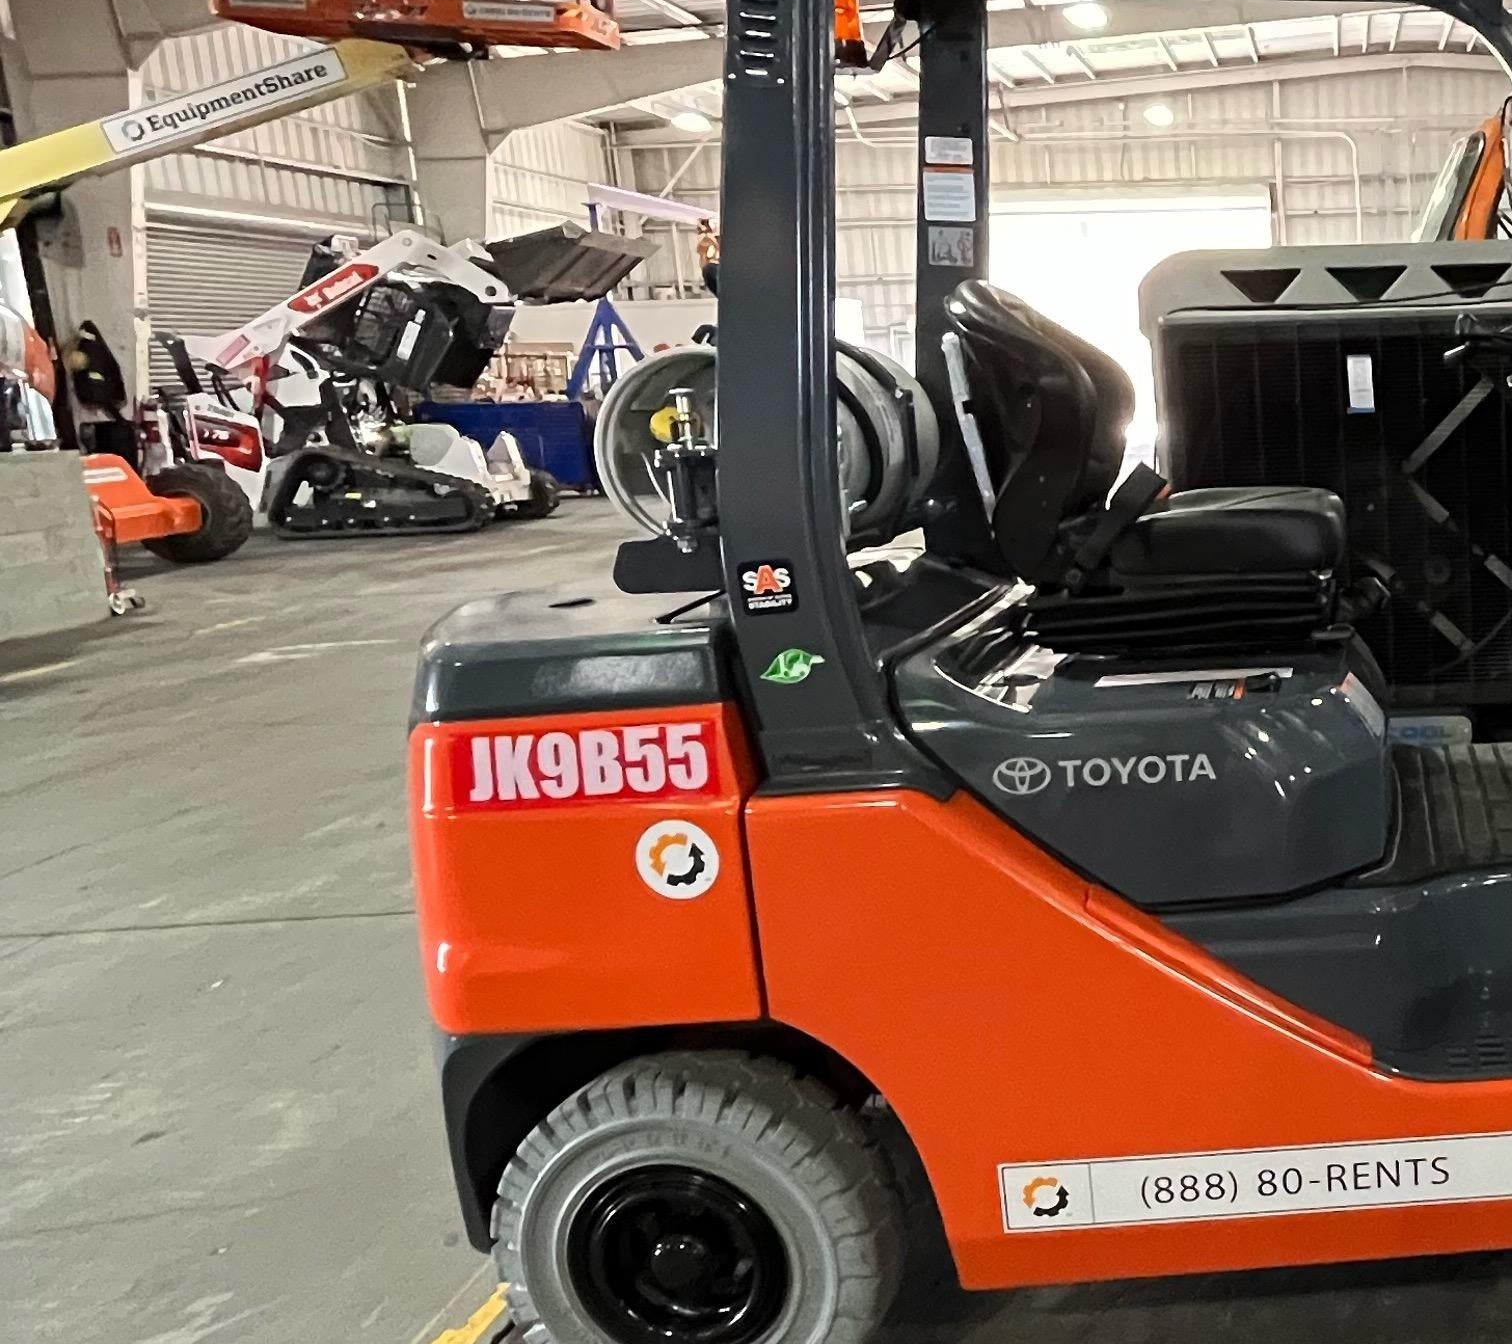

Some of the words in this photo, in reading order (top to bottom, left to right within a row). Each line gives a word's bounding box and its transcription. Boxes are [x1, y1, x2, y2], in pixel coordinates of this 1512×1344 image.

[146, 64, 328, 133] EquipmentShare
[742, 564, 791, 595] SAS
[469, 723, 709, 802] JK9B55
[1058, 753, 1217, 787] TOYOTA
[1140, 1170, 1239, 1209] (888)
[1257, 1156, 1451, 1198] 80-RENTS
